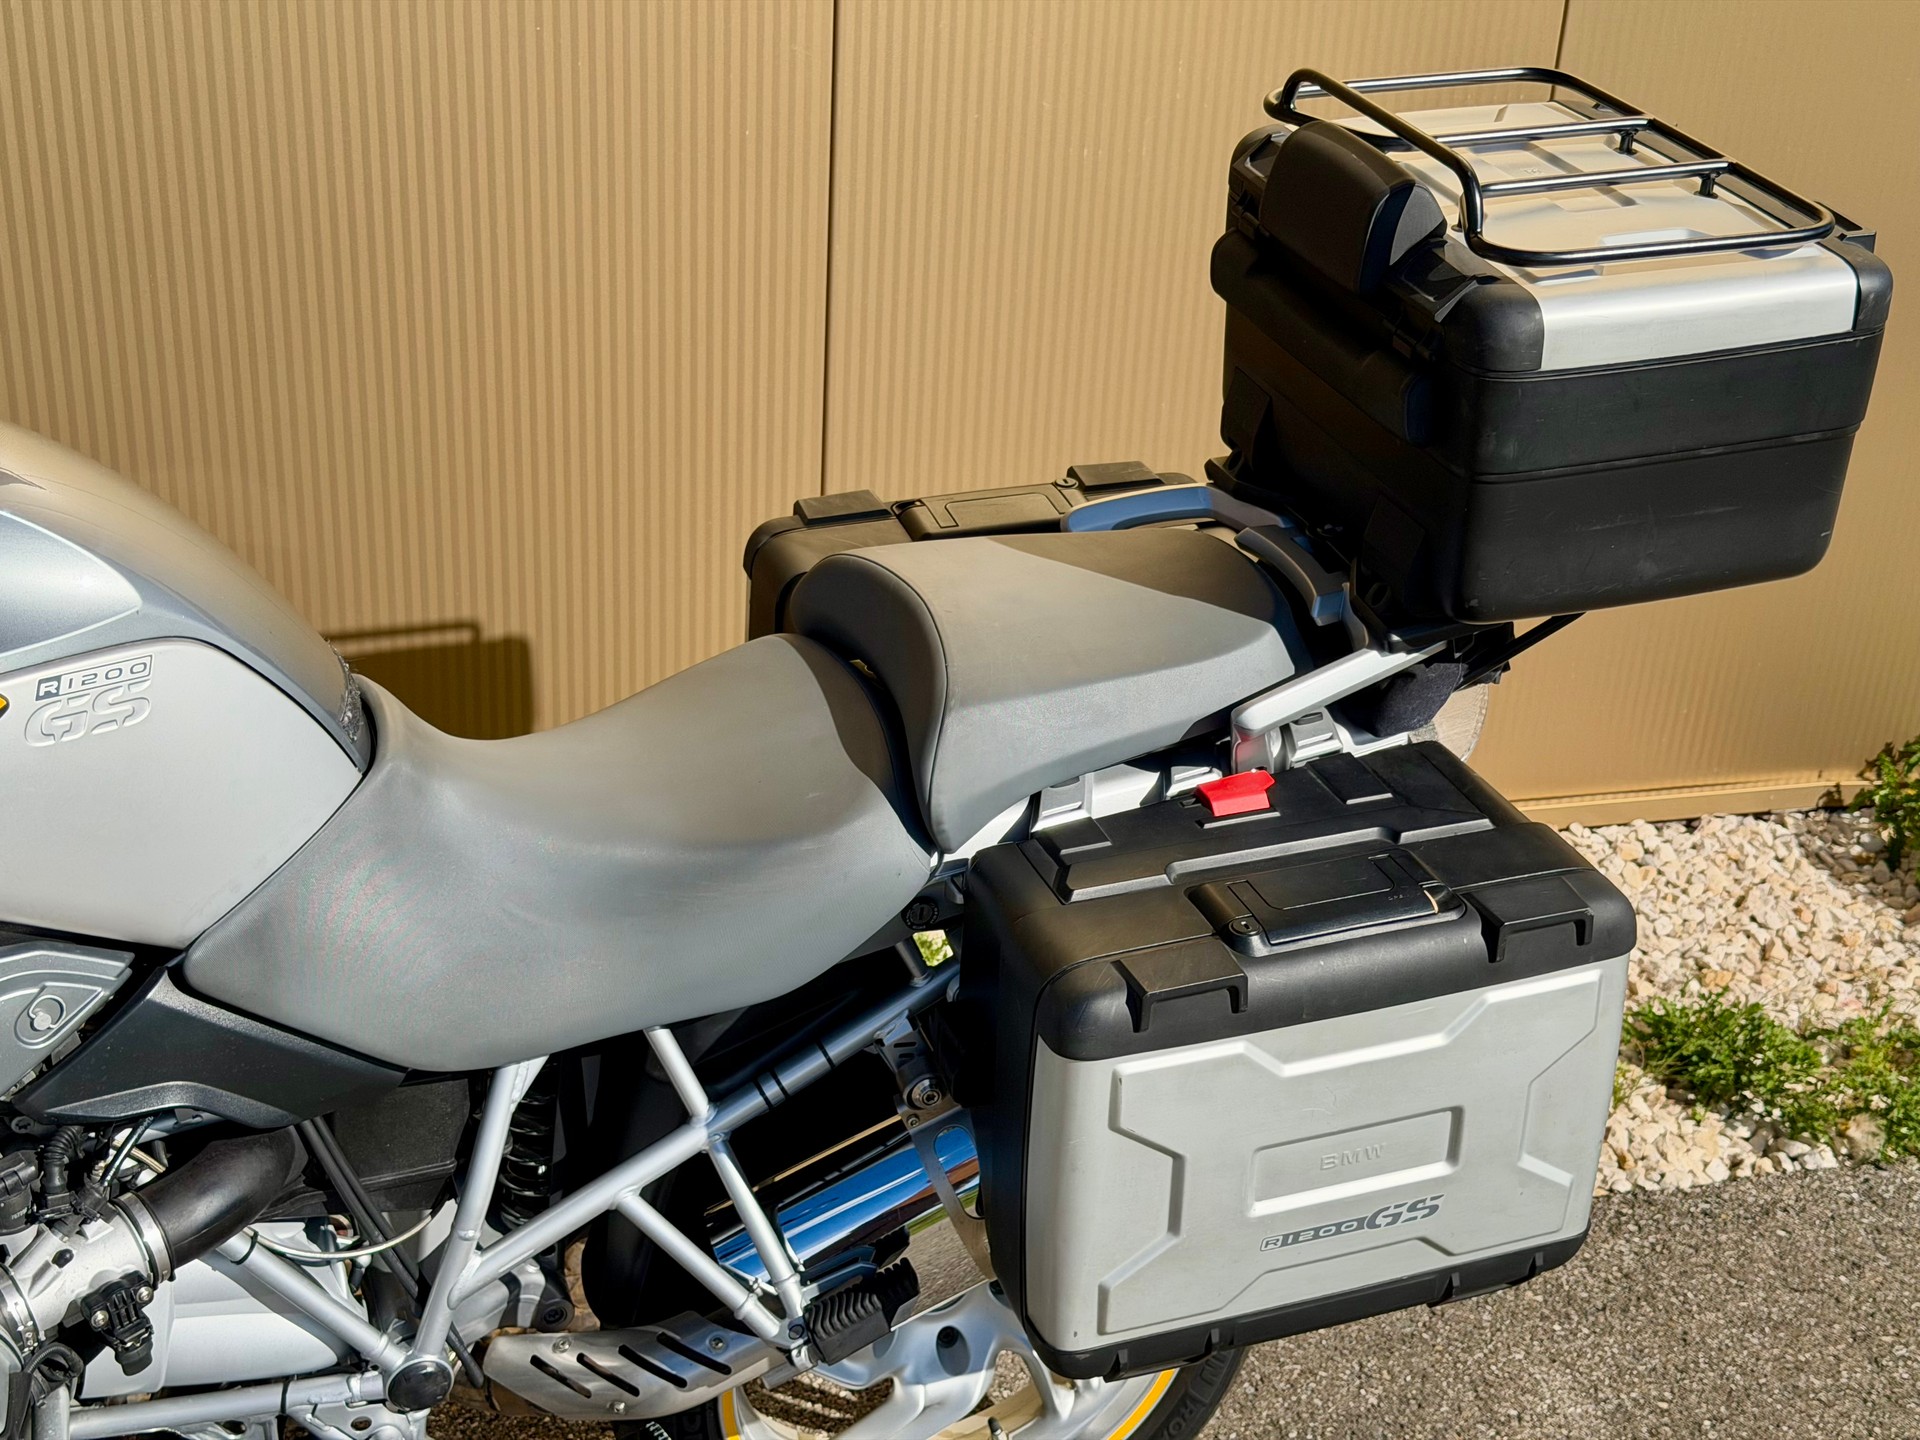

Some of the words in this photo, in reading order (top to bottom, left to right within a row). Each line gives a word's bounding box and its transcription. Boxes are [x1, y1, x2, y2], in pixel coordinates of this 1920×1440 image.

[37, 659, 150, 699] R1200
[24, 678, 151, 747] GS
[1319, 1142, 1387, 1171] BMW
